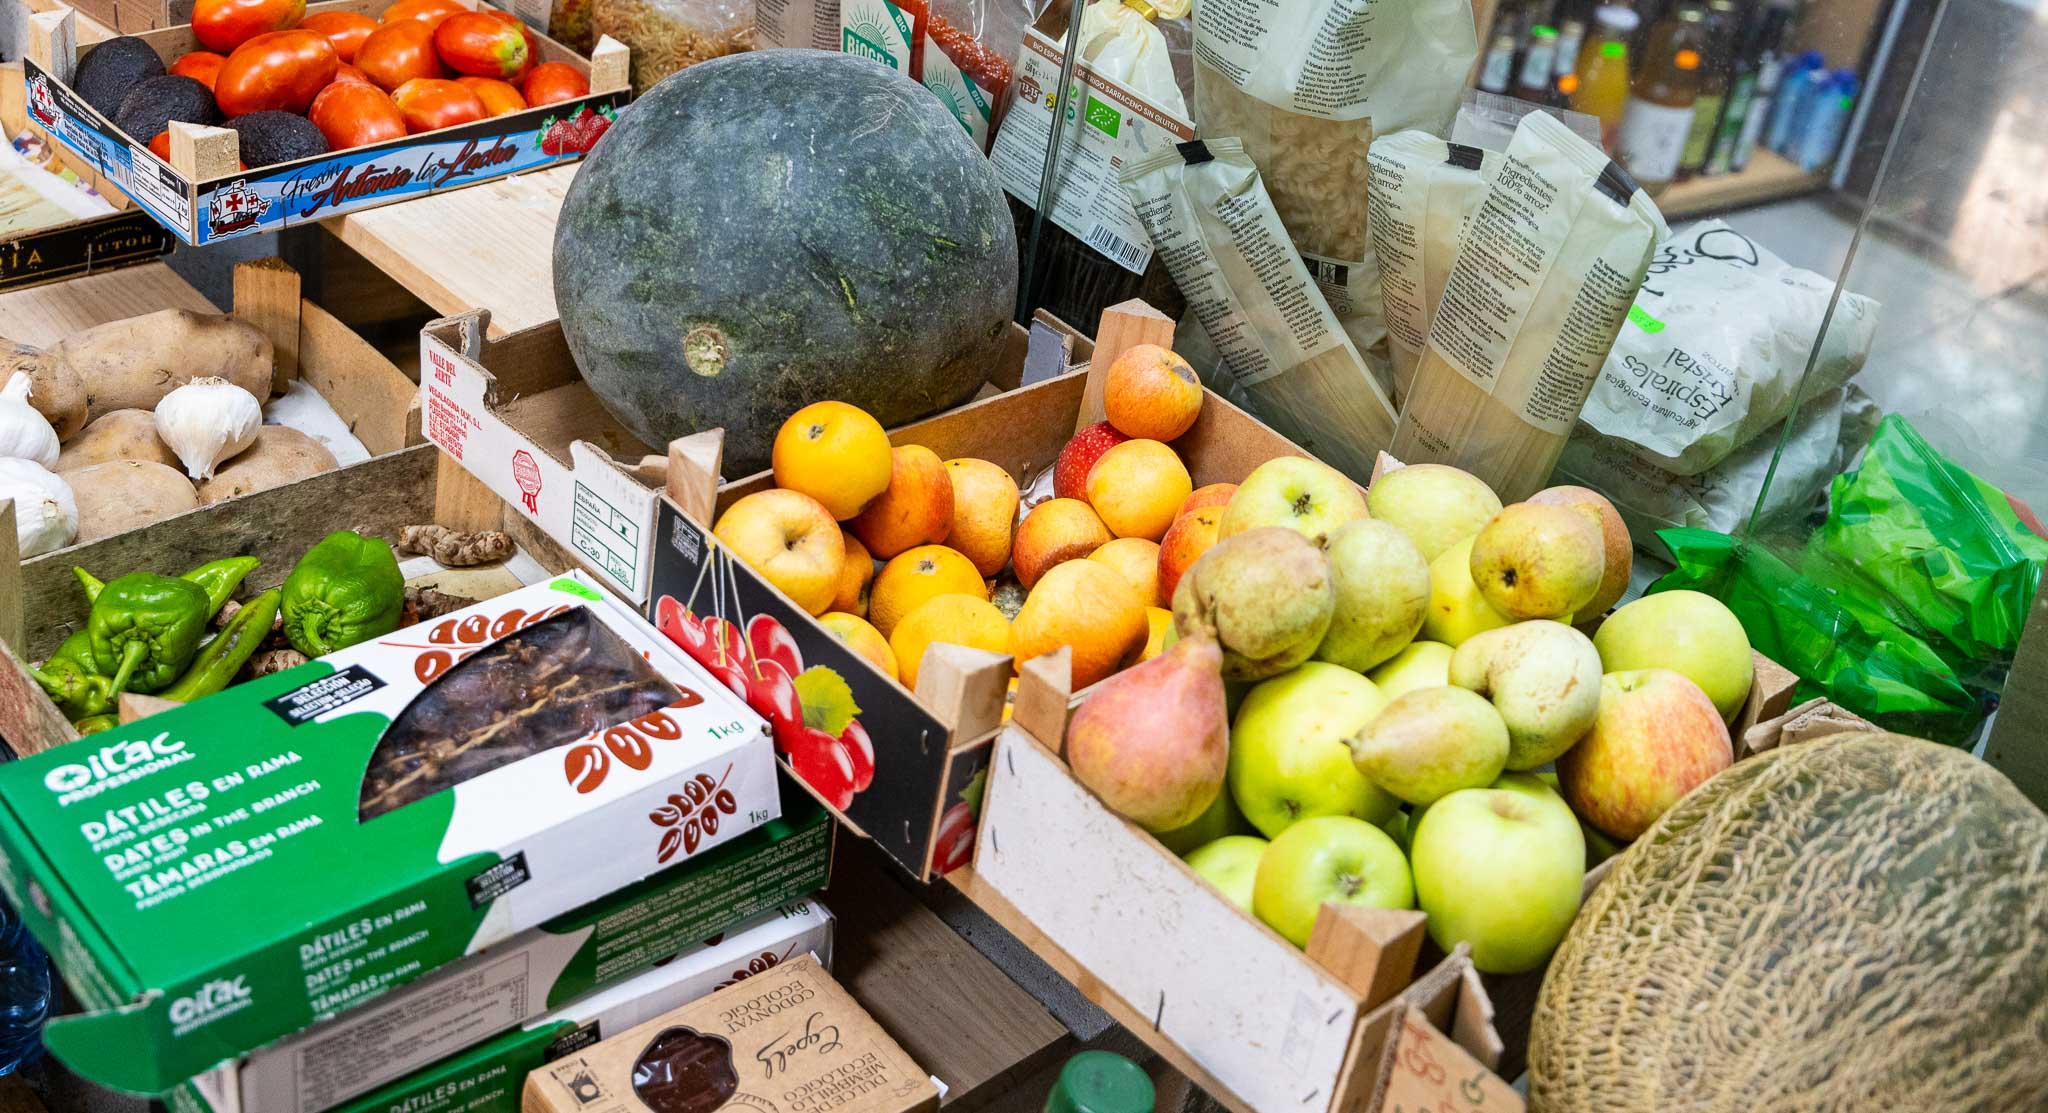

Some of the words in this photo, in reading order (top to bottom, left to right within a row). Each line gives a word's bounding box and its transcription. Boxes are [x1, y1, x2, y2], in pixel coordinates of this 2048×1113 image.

[896, 15, 907, 33] BIO
[972, 89, 984, 107] BIO
[1019, 81, 1039, 99] 13-15
[1032, 41, 1044, 52] BIO
[1076, 68, 1087, 80] DE
[1086, 74, 1105, 90] TRIGO
[1103, 84, 1144, 113] SARRACENO
[1142, 106, 1155, 118] SIN
[1154, 114, 1180, 133] GLUTEN
[415, 151, 438, 183] la
[434, 136, 519, 188] Lacha
[1367, 160, 1405, 184] redientes:
[1508, 154, 1535, 175] Agricultura
[1534, 171, 1558, 192] Ecológica
[280, 160, 344, 208] Fresón
[301, 163, 412, 219] Antonia
[1490, 184, 1522, 208] Procedente
[1521, 205, 1530, 214] de
[1528, 209, 1536, 217] la
[1497, 172, 1523, 195] 100%
[1502, 161, 1554, 204] Ingredientes:
[429, 348, 444, 370] VALLE
[445, 359, 455, 377] DEL
[434, 365, 451, 388] JERTE
[1663, 347, 1734, 408] Kristal
[1605, 372, 1651, 406] Ecológica
[1621, 354, 1719, 420] Espirales
[1651, 403, 1701, 429] Agricultura
[577, 491, 600, 515] ESPAÑA
[580, 537, 600, 561] C-30
[291, 675, 351, 706] SELECCIÓN
[705, 717, 745, 742] 1kg
[58, 748, 196, 808] PROFESSIONAL
[81, 781, 210, 843] DÁTILES
[211, 769, 245, 794] EN
[246, 747, 301, 779] RAMA
[92, 828, 136, 853] FRUTA
[138, 800, 206, 835] DESECADA
[104, 826, 189, 873] DATES
[189, 820, 212, 839] IN
[213, 805, 250, 830] THE
[251, 778, 320, 814] BRANCH
[747, 805, 771, 826] 1kg
[113, 859, 152, 882] DRIED
[153, 844, 188, 866] FRUIT
[125, 840, 247, 899] TÂMARAS
[247, 829, 277, 851] EM
[276, 811, 322, 839] RAMA
[300, 917, 371, 961] DÁTILES
[374, 912, 393, 930] EN
[394, 899, 426, 920] RAMA
[305, 957, 352, 989] DATES
[353, 956, 365, 968] IN
[366, 946, 386, 962] THE
[389, 928, 428, 952] BRANCH
[311, 974, 377, 1013] TÂMARAS
[379, 970, 394, 984] EM
[395, 959, 420, 976] RAMA
[724, 988, 816, 1034] CODONYAT
[458, 1077, 476, 1090] EN
[476, 1064, 507, 1082] RAMA
[787, 1060, 887, 1111] MEMBRILLO
[830, 1073, 889, 1106] DULCE
[805, 1100, 833, 1113] DE
